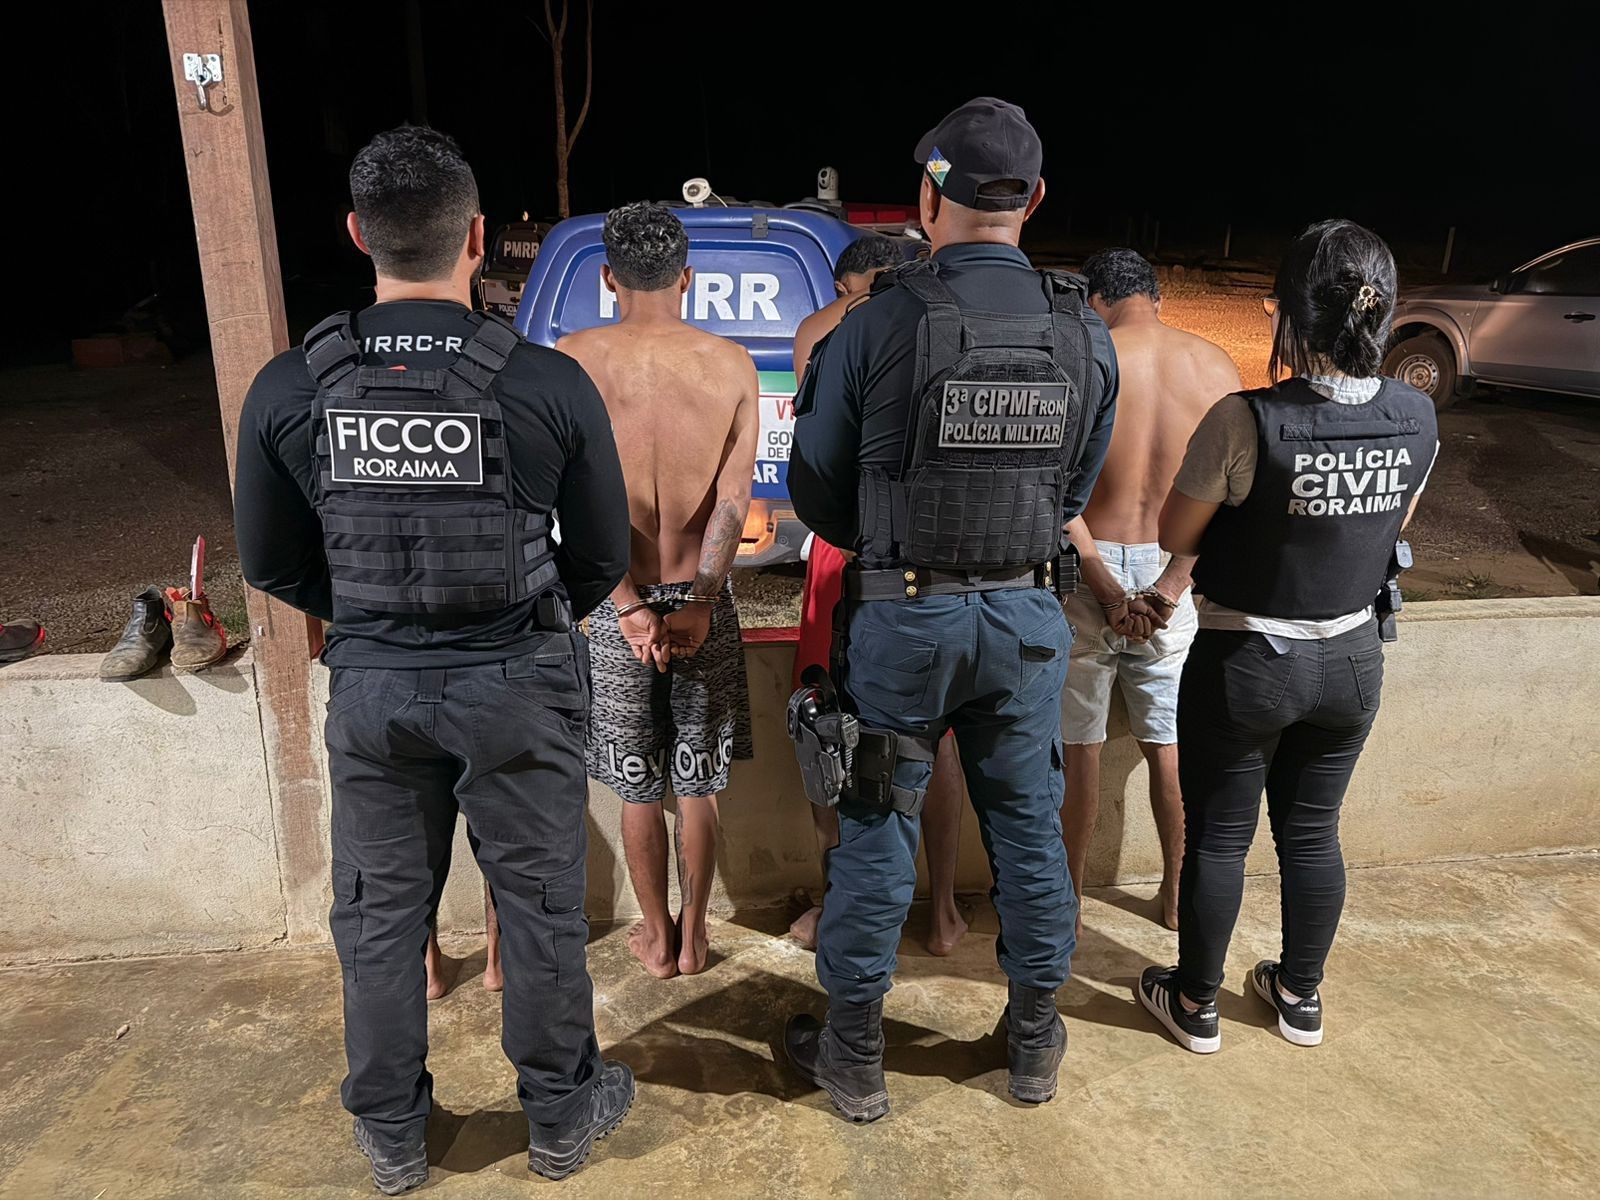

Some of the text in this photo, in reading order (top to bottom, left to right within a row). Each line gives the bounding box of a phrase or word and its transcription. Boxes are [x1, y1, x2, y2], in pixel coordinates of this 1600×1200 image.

[503, 241, 540, 259] PMRR
[600, 272, 781, 321] RR
[336, 416, 472, 454] FICCO
[943, 419, 1061, 442] POLÍCIA MILITAR
[768, 447, 784, 458] DE
[1294, 446, 1412, 473] POLÍCIA
[353, 457, 459, 478] RORAIMA
[1291, 468, 1409, 498] CIVIL
[1287, 492, 1402, 516] RORAIMA
